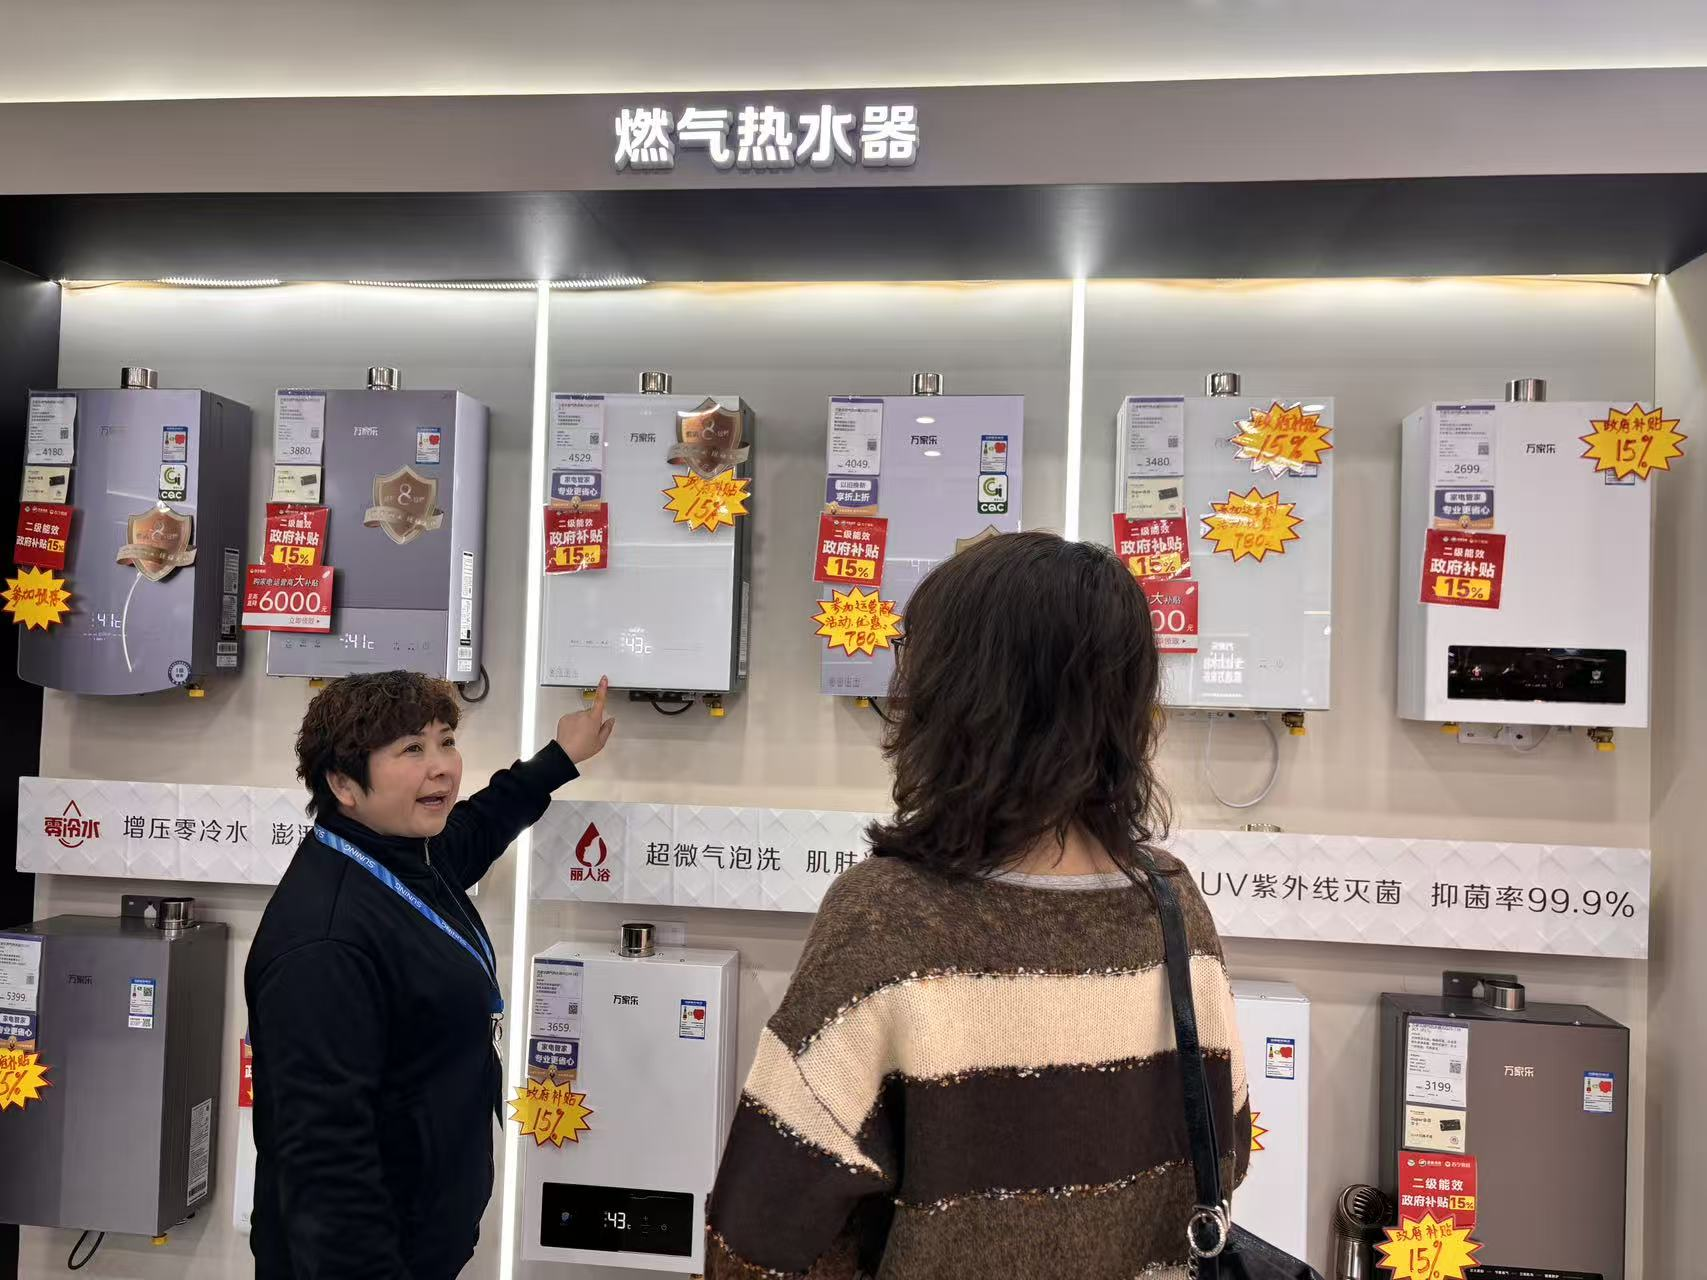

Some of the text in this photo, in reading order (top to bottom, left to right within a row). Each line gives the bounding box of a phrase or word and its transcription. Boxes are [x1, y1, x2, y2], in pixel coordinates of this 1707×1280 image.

[615, 104, 919, 169] 燃气热水器
[911, 435, 938, 445] 万家乐
[1526, 444, 1556, 454] 万家乐
[1617, 435, 1653, 468] 15%
[161, 491, 183, 499] CQC
[981, 503, 1004, 512] CQC
[25, 522, 60, 535] 二级能效
[280, 519, 312, 529] 二级能效
[559, 518, 593, 528] 二级能效
[16, 535, 48, 549] 政府补贴
[270, 529, 319, 546] 政府补贴
[549, 529, 603, 545] 政府补贴
[834, 529, 871, 541] 二级能效
[823, 540, 879, 559] 政府补贴
[1121, 536, 1182, 555] 政府补贴
[1443, 547, 1485, 559] 二级能效
[280, 547, 309, 564] 15%
[563, 547, 595, 564] 15%
[835, 559, 869, 577] 15%
[1137, 556, 1175, 575] 15%
[1430, 558, 1495, 578] 政府补贴
[1444, 578, 1483, 598] 15%
[44, 816, 100, 838] 零冷水
[123, 815, 248, 843] 增压零冷水
[344, 844, 376, 868] SUNING
[645, 842, 781, 871] 超微气泡洗
[570, 867, 611, 882] 丽人浴
[394, 882, 422, 907] SUNING
[1431, 882, 1635, 919] 抑菌率99.9%
[613, 994, 639, 1005] 万家乐
[1504, 1065, 1534, 1076] 万家乐
[533, 1107, 565, 1140] 15%
[1412, 1178, 1464, 1191] 二级能效
[1401, 1194, 1474, 1209] 政府补贴 15%
[1409, 1240, 1442, 1280] 15%
